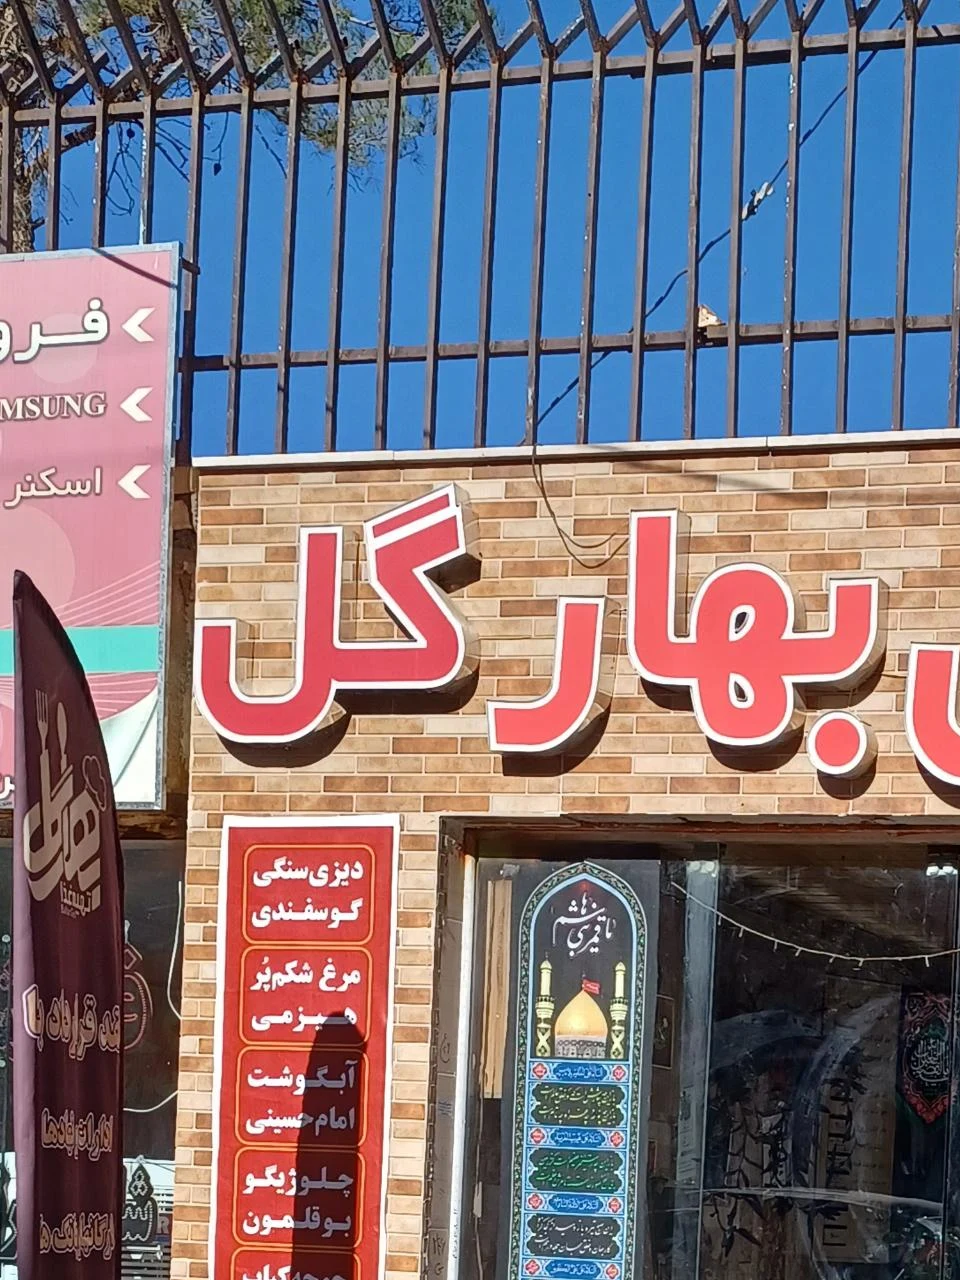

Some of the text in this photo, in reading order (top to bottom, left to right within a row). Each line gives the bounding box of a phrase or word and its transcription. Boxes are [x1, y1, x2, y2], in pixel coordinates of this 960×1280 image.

[4, 467, 103, 508] اسکنر
[193, 483, 470, 743] گل
[487, 507, 882, 778] بهار
[252, 856, 364, 888] دیزی سنگی
[251, 897, 364, 930] گوسفندی
[318, 957, 362, 992] مرغ
[251, 1005, 358, 1033] هیزمی
[247, 1060, 359, 1096] آبگوشت
[245, 1106, 356, 1136] امام حسینی
[297, 1166, 355, 1198] چلو
[242, 1206, 353, 1237] بوقلمون
